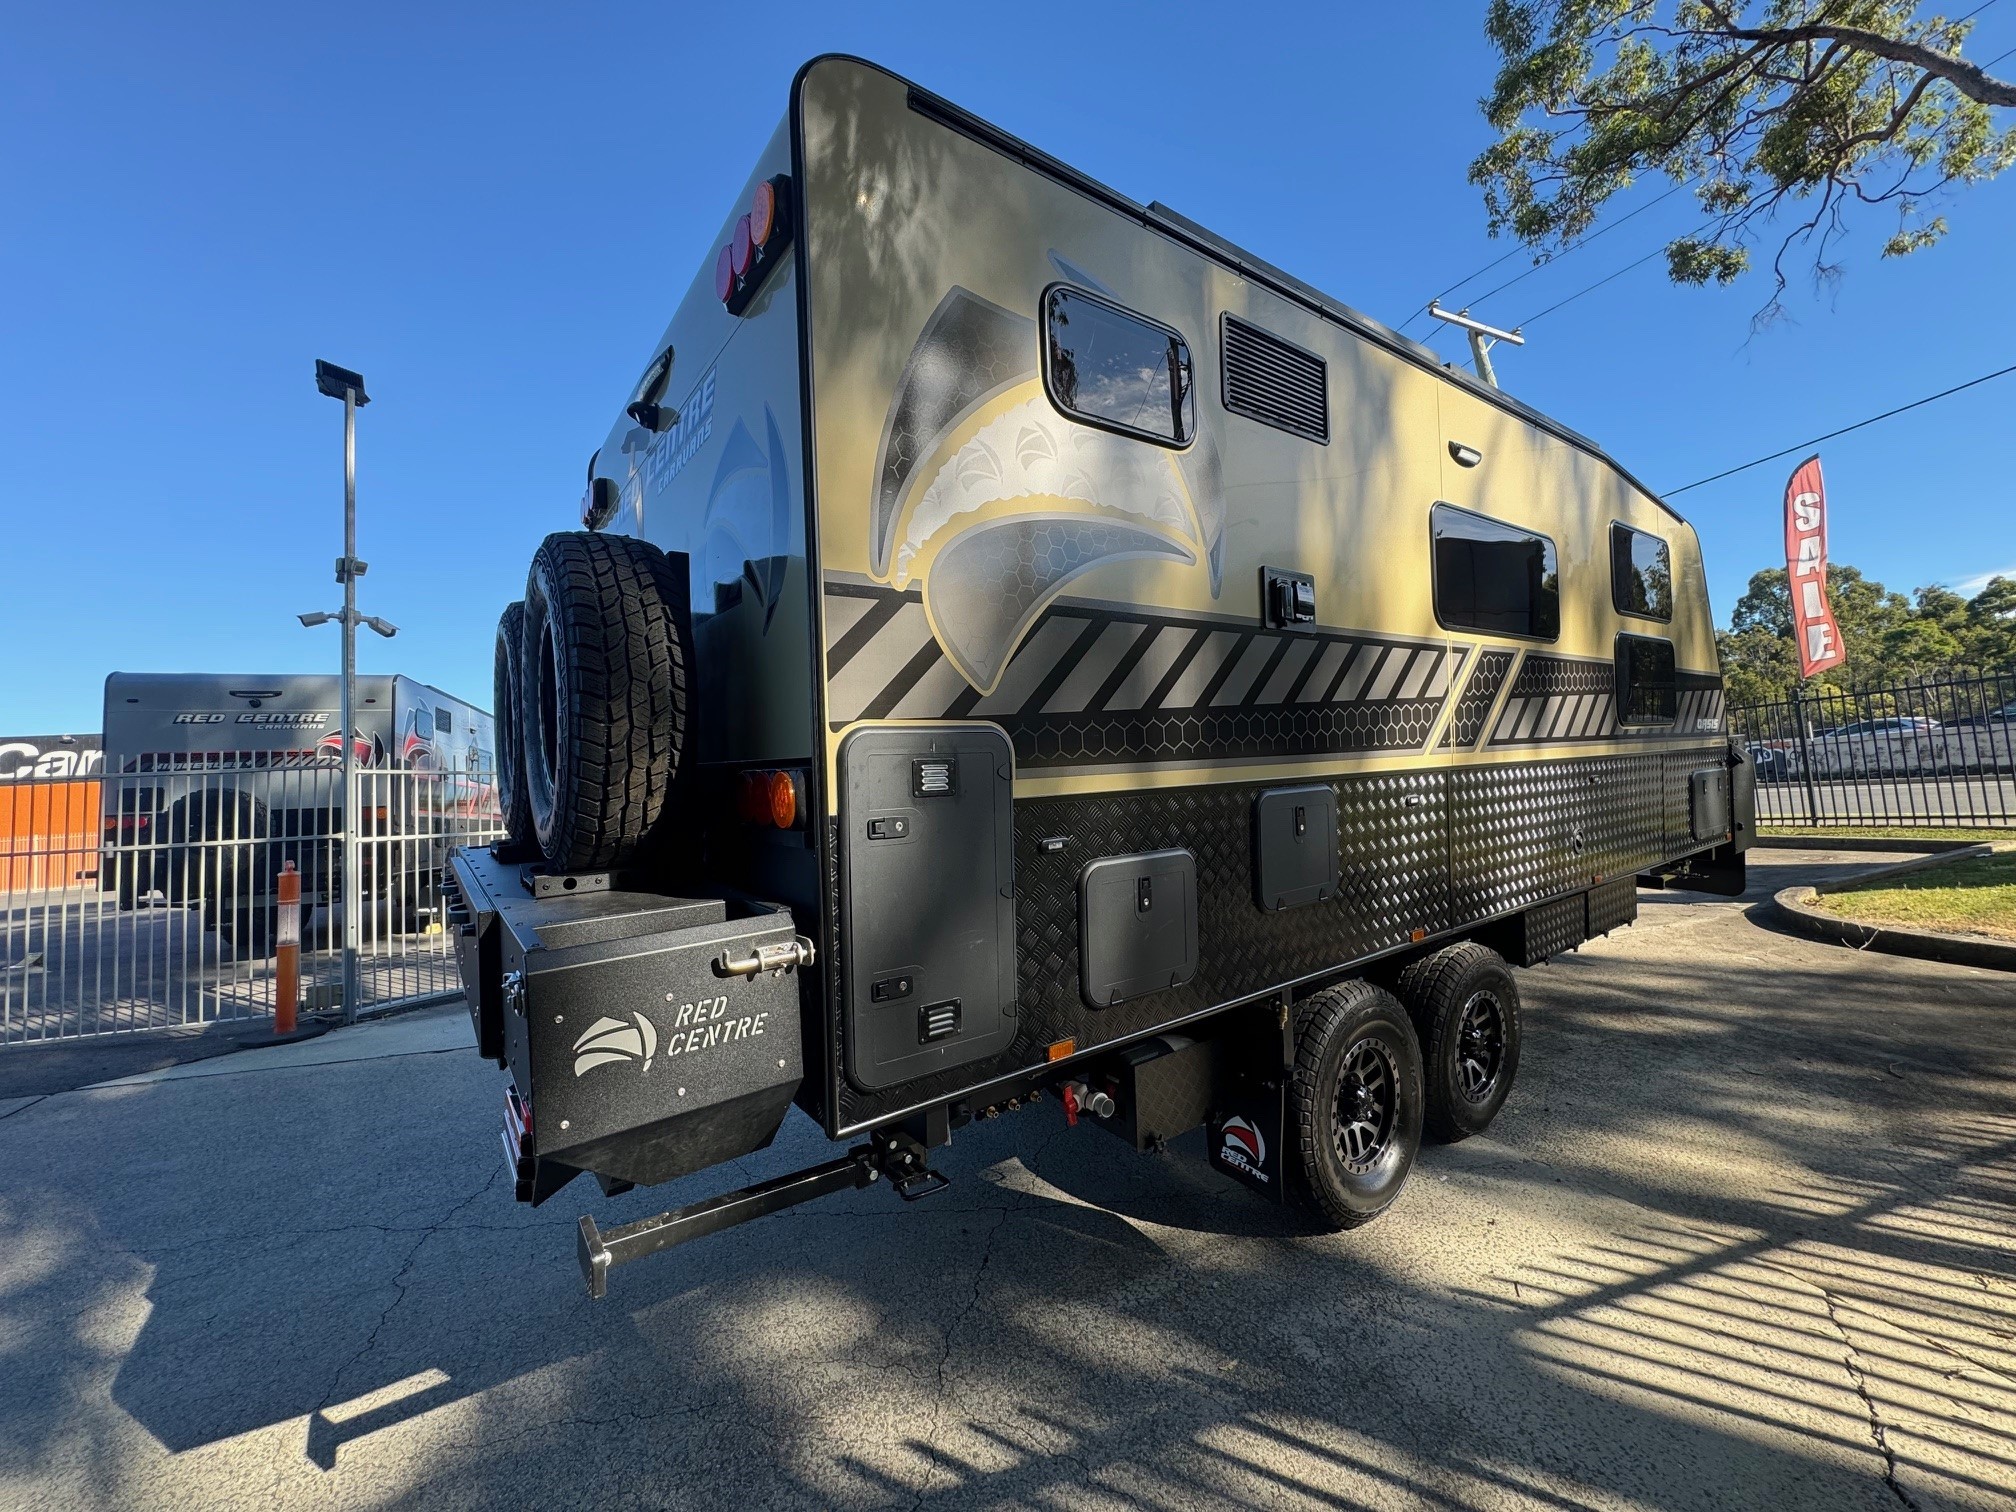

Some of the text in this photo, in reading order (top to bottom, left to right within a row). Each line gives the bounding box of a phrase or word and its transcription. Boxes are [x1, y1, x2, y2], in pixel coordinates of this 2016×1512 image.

[647, 367, 716, 483] CENTRE
[1793, 491, 1836, 662] SALE
[174, 713, 330, 724] RED CENTRE
[1697, 718, 1719, 732] OASIS
[674, 996, 728, 1027] RED
[667, 1012, 769, 1056] CENTRE
[1220, 1152, 1269, 1182] CENTRE
[1221, 1146, 1247, 1162] RED
